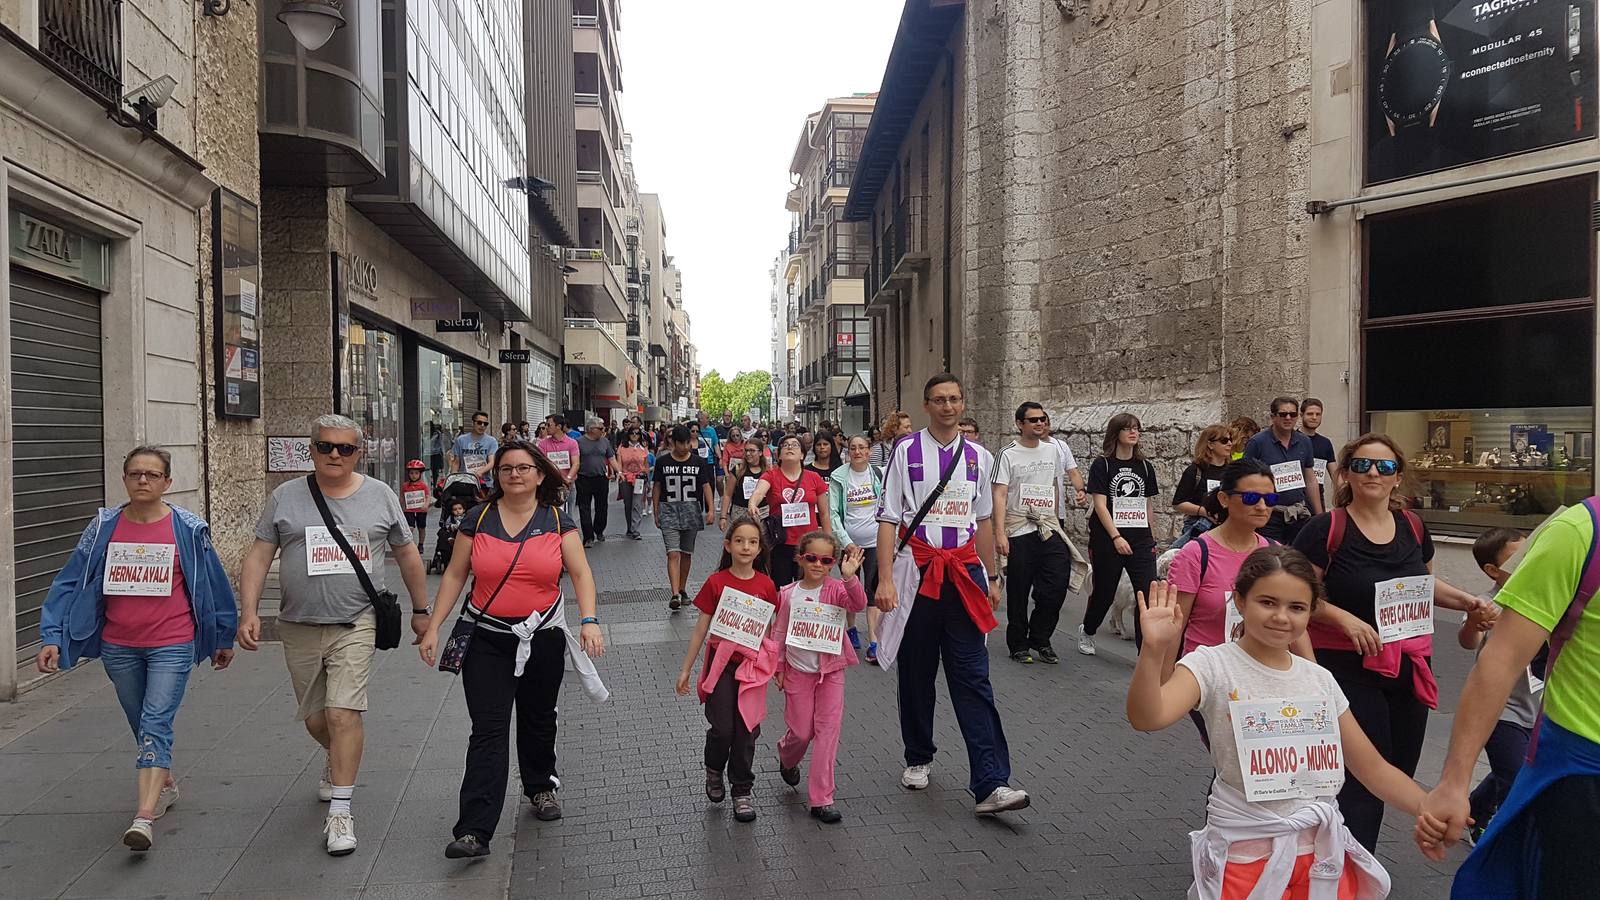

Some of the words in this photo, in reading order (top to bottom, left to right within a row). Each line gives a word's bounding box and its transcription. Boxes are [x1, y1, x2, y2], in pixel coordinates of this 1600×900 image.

[1471, 34, 1522, 55] MODULAR
[1528, 27, 1543, 38] 45
[1461, 46, 1556, 80] #connectedtoeternity
[25, 220, 72, 263] ZARA
[350, 255, 377, 294] KIKO
[504, 352, 525, 361] Sfera
[665, 475, 697, 502] 92
[1275, 472, 1303, 485] TRECEÑO
[784, 512, 807, 520] ALBA
[1115, 509, 1146, 520] TRECEÑO
[311, 545, 344, 564] HERNAZ
[108, 565, 143, 583] HERNAZ
[142, 566, 170, 583] AYALA
[717, 607, 765, 638] PASCUAL-GENICIO
[1379, 605, 1397, 628] REYES
[1397, 600, 1430, 624] CATALINA
[790, 620, 820, 639] HERNAZ
[819, 624, 841, 642] AYALA
[1250, 746, 1298, 776] ALONSO
[1306, 739, 1339, 771] MUÑOZ
